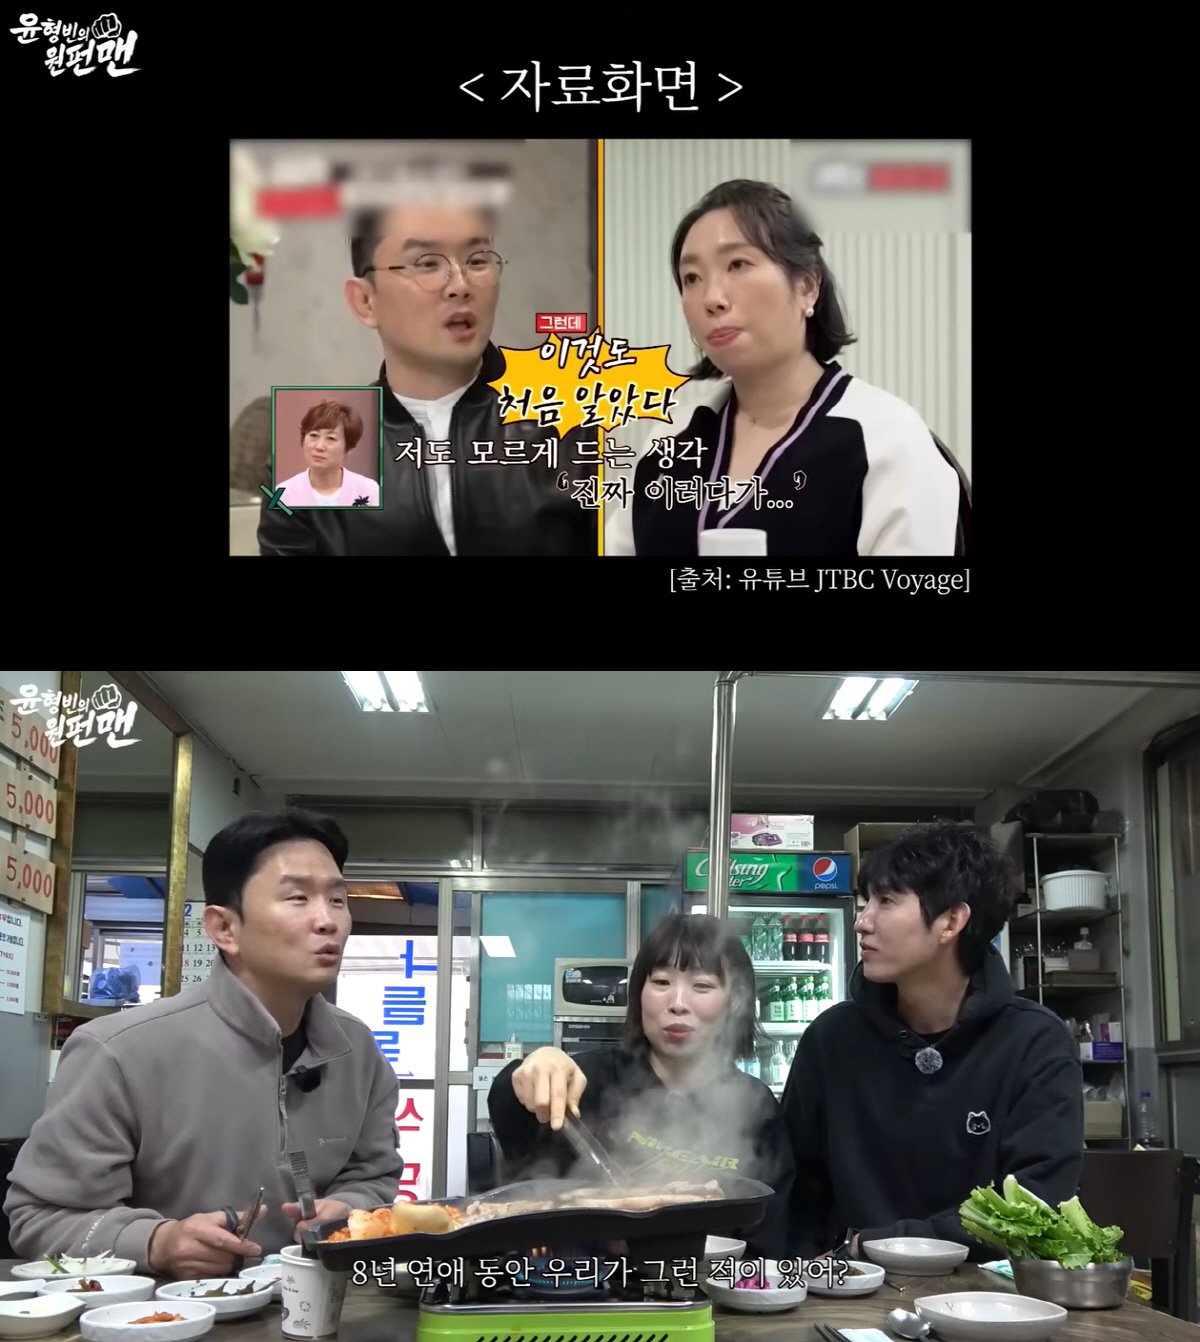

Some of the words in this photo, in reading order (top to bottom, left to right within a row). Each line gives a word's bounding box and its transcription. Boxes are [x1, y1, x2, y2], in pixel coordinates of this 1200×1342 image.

[6, 783, 54, 824] 5,000
[6, 856, 53, 899] 5,000
[814, 881, 838, 891] pepsi
